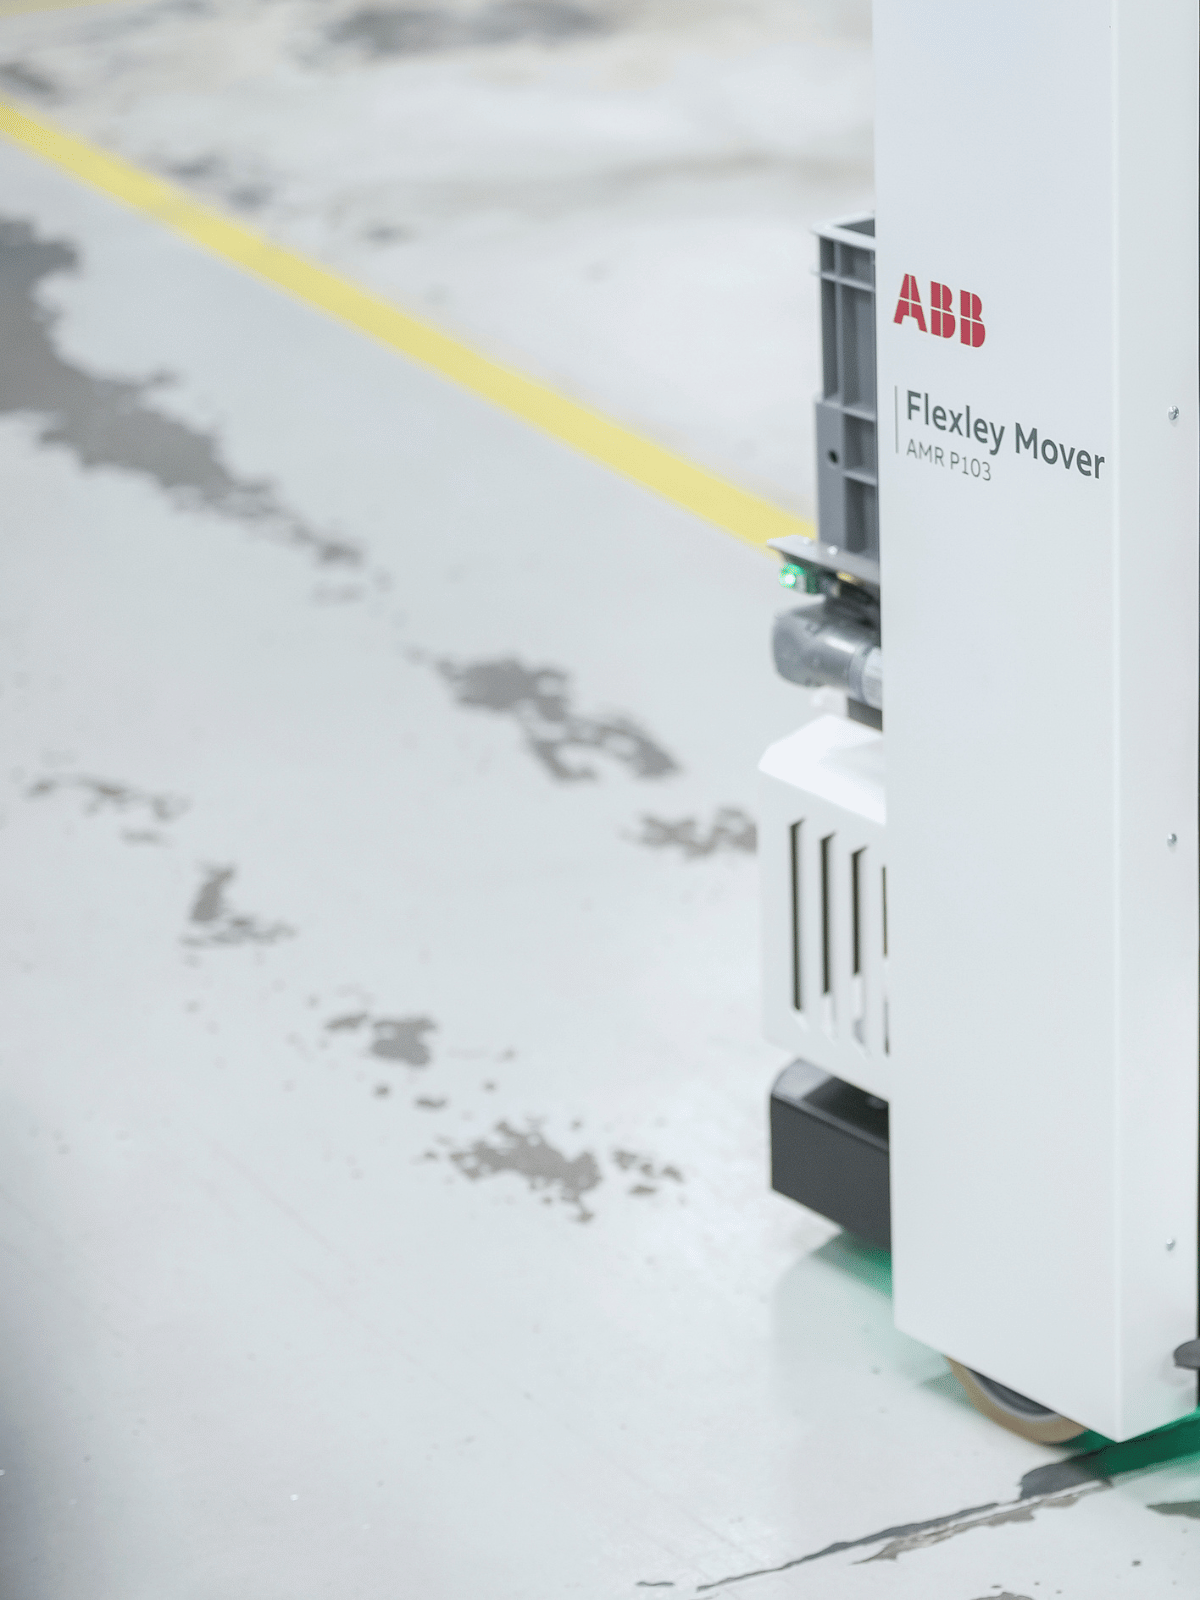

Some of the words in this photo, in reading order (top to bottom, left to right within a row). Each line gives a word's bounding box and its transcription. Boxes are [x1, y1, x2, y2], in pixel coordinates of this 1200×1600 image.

[893, 273, 986, 348] ABB
[906, 389, 1006, 456] Flexley
[1014, 421, 1106, 480] Mover
[906, 438, 945, 467] AMR
[949, 450, 992, 482] P103
